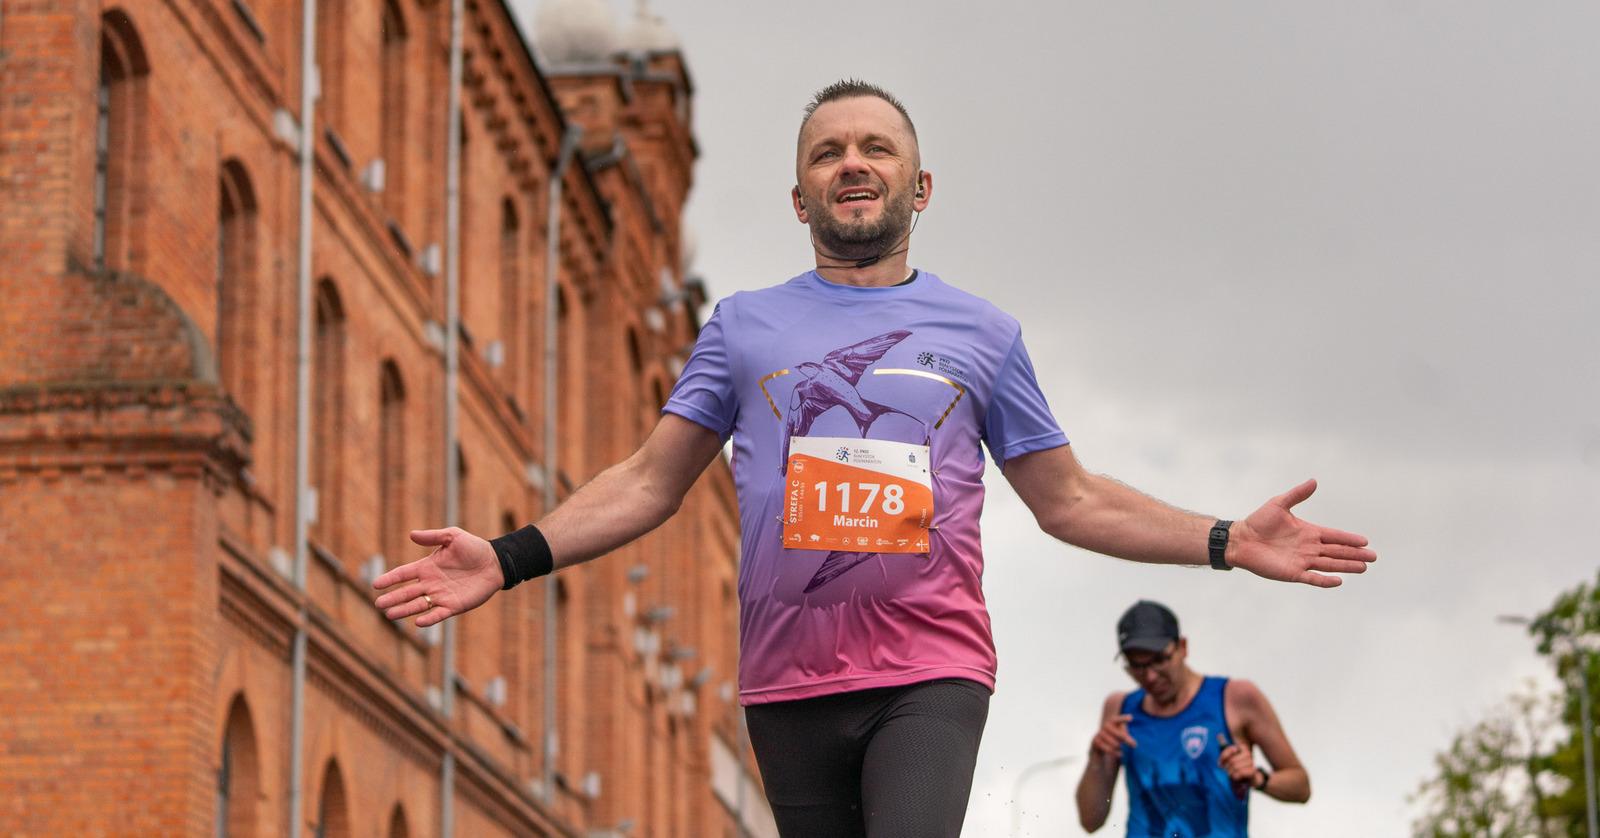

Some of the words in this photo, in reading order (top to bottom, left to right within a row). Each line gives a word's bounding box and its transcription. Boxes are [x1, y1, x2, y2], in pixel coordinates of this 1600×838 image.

[791, 479, 800, 487] C
[789, 489, 799, 523] STREFA
[815, 481, 905, 515] 1178
[833, 515, 879, 528] Marcin
